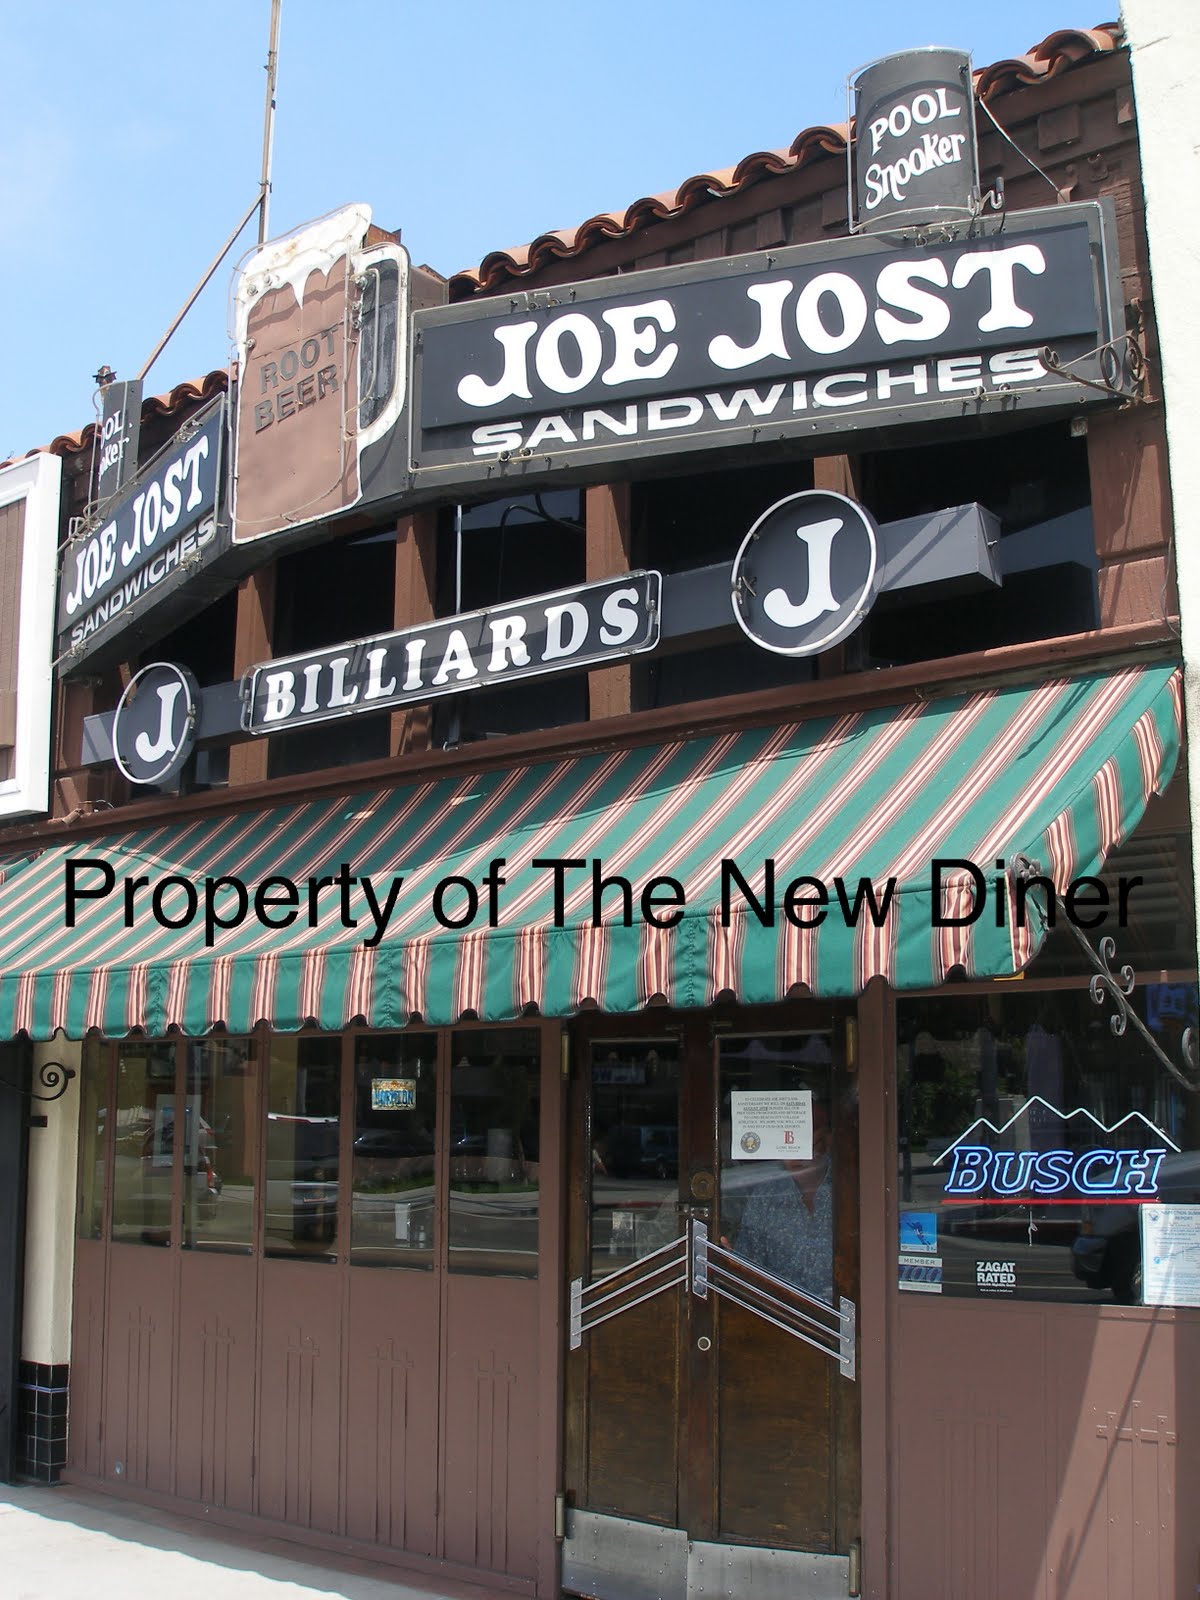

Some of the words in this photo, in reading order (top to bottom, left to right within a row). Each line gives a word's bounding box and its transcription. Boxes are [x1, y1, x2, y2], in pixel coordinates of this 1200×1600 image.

[869, 88, 961, 156] POOL
[865, 133, 966, 210] Snooker
[260, 328, 338, 395] ROOT
[457, 298, 679, 408] JOE
[707, 243, 1046, 370] JOST
[254, 364, 341, 434] BEER
[471, 347, 1050, 457] SANDWICHES
[66, 521, 117, 615] JOE
[120, 436, 210, 568] JOST
[71, 515, 215, 647] SANDWICHES
[763, 517, 844, 629] J
[263, 588, 640, 723] BILLIARDS
[135, 681, 183, 762] J
[944, 1146, 1167, 1195] BUSCH
[903, 1257, 936, 1266] MEMBER
[976, 1262, 1015, 1272] ZAGAT
[976, 1273, 1016, 1283] RATED
